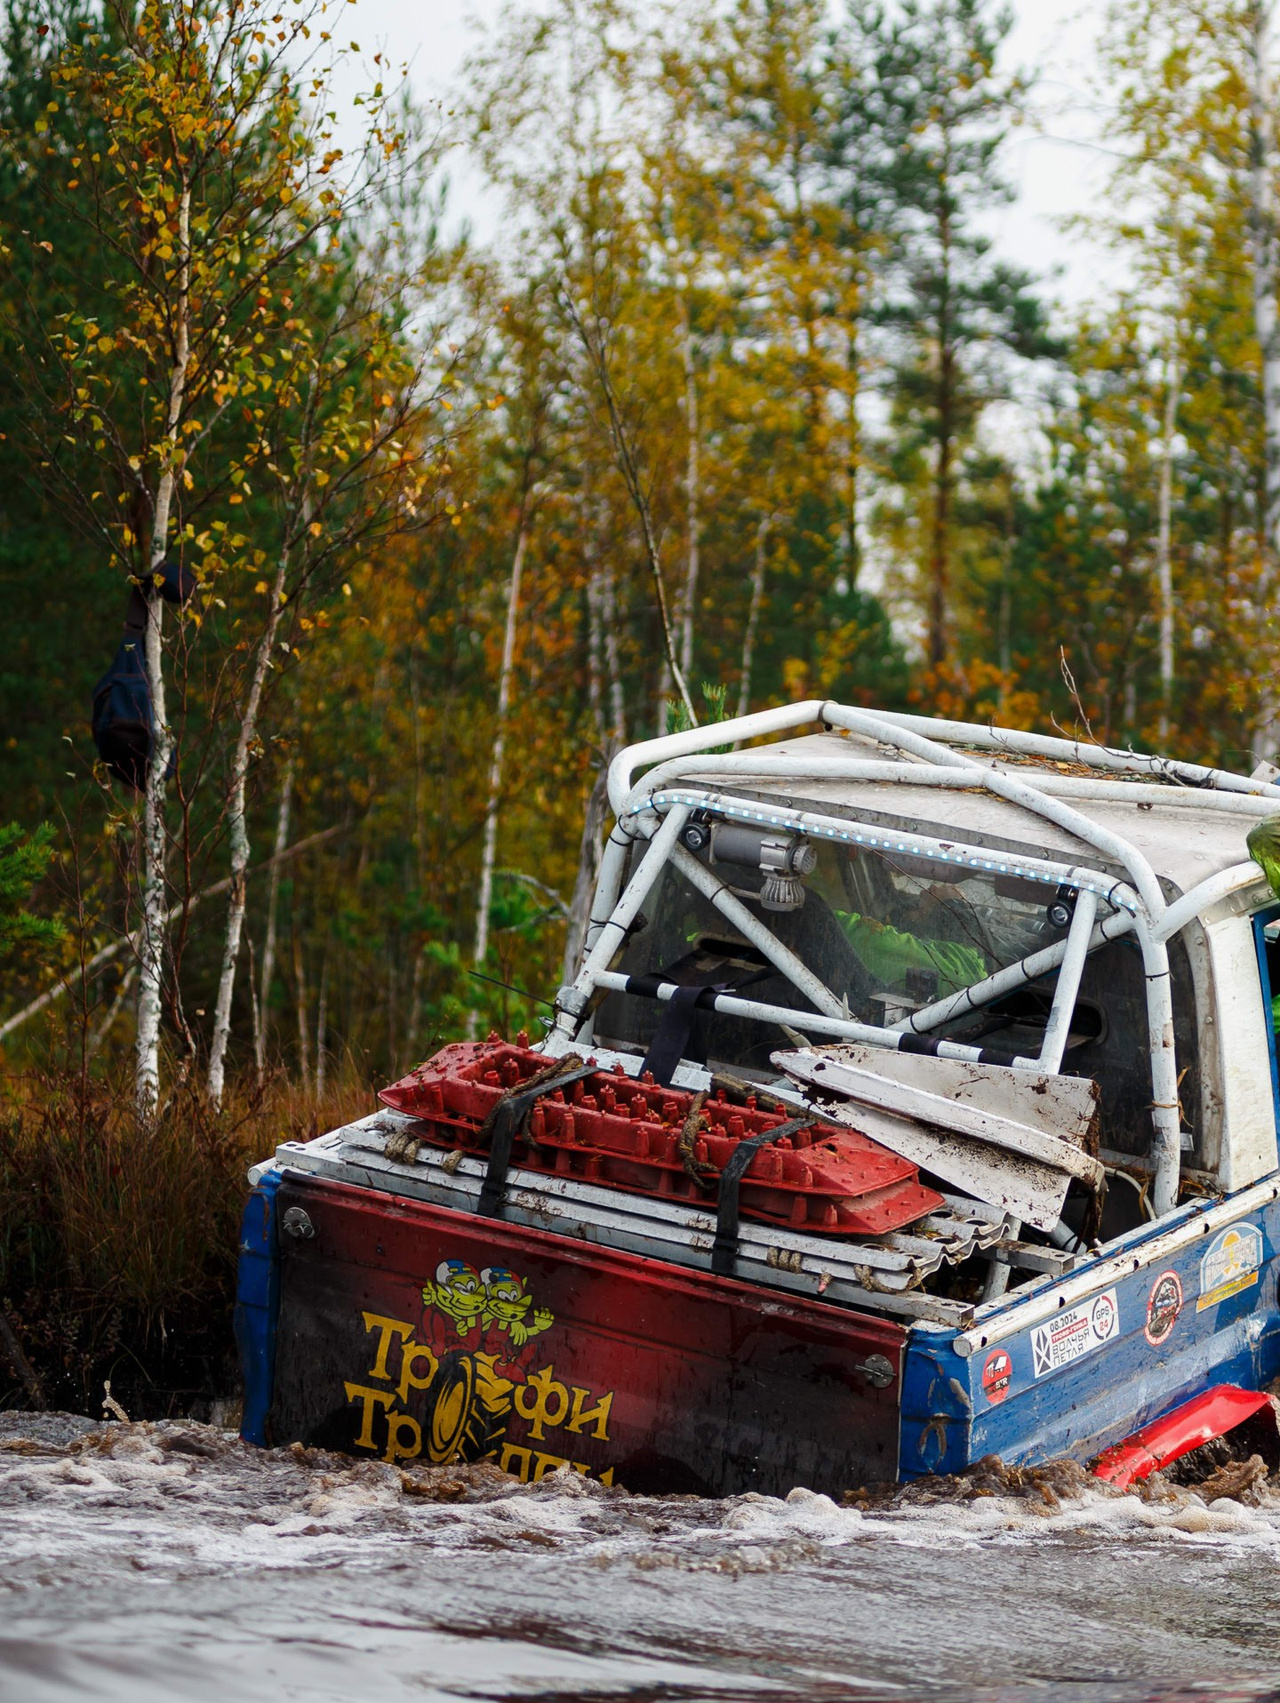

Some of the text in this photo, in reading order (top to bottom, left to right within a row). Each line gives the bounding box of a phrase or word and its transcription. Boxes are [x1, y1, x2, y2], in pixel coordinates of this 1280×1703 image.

[1096, 1306, 1109, 1320] GPS
[1099, 1319, 1109, 1331] 24
[1053, 1328, 1090, 1355] ВОЛЧЬЯ
[1053, 1343, 1084, 1366] ПЕТЛЯ
